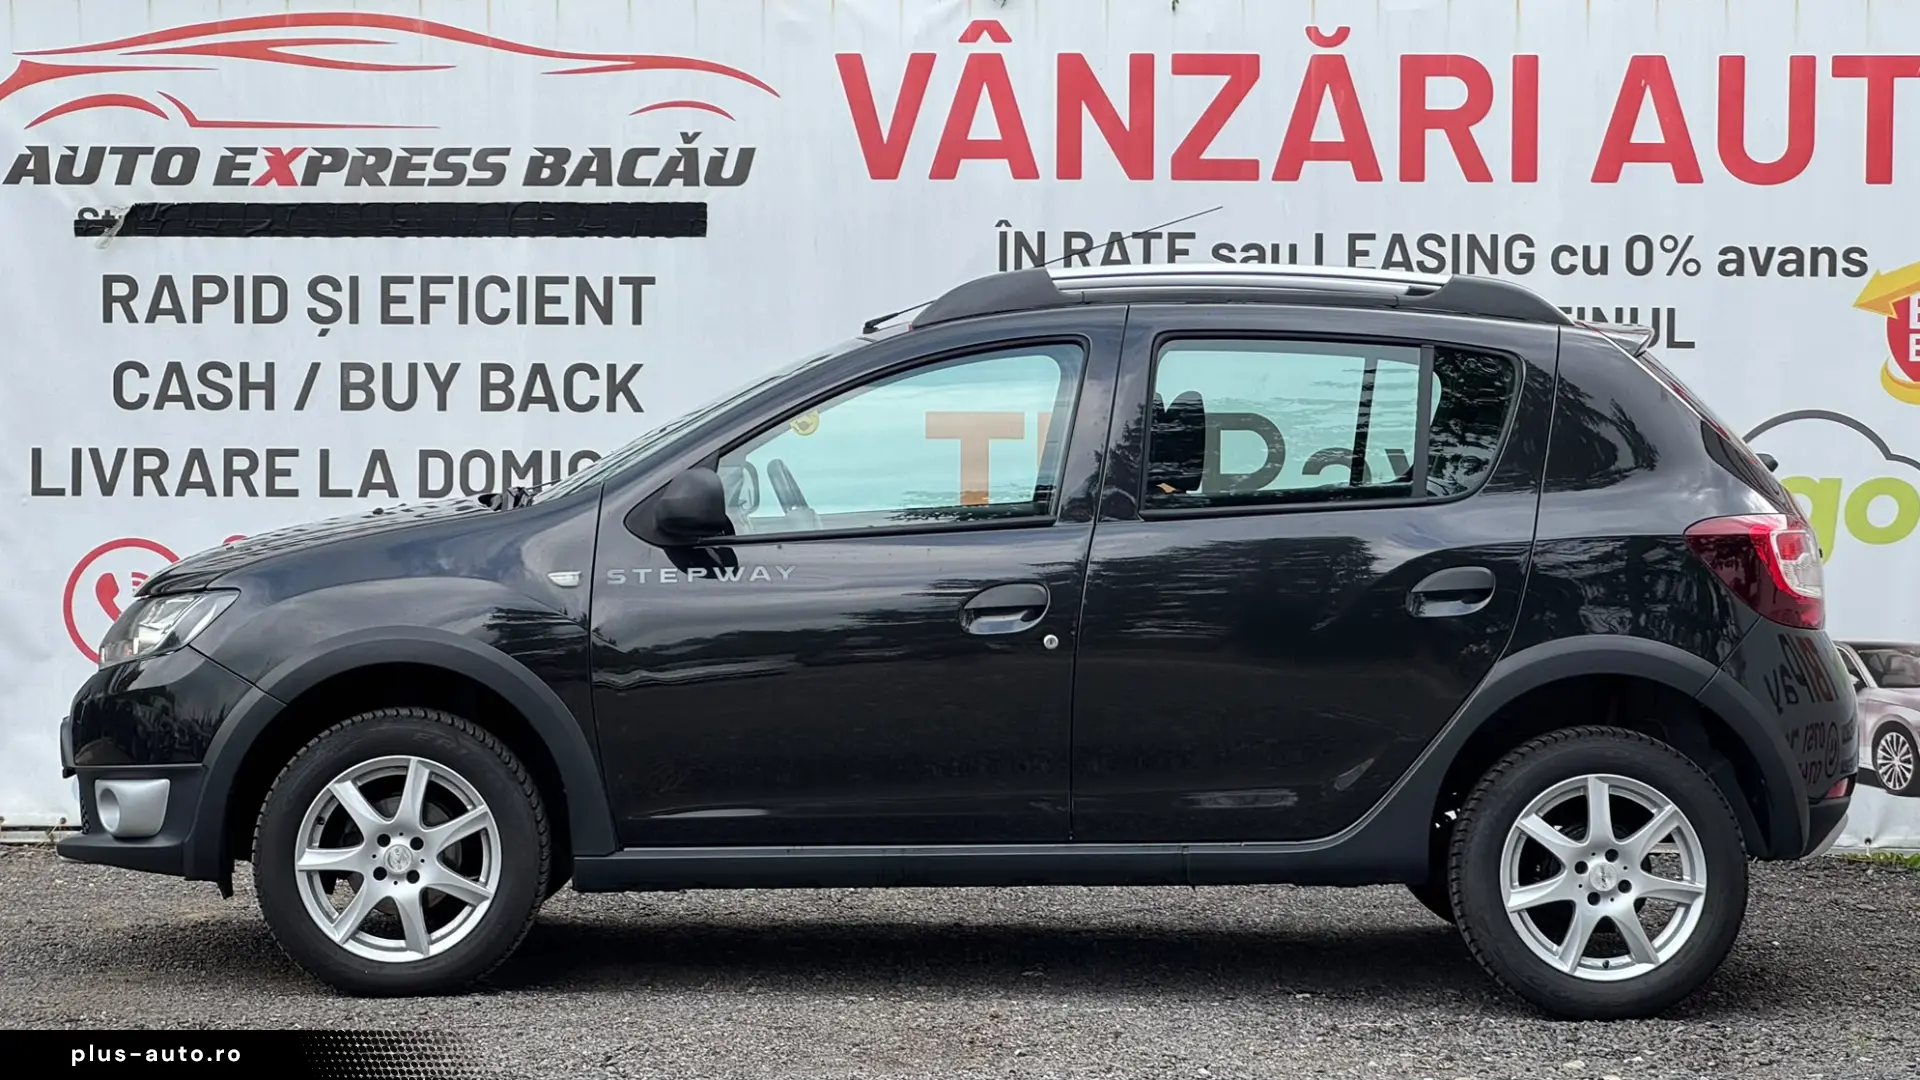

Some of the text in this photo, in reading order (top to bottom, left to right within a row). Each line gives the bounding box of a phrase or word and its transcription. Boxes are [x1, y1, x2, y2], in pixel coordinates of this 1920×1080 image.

[835, 20, 1920, 186] VÂNZĂRI AUT
[3, 131, 756, 187] AUTO EXPRESS BACĂU
[995, 219, 1046, 272] ÎN
[1551, 245, 1609, 276] cu
[1625, 234, 1702, 277] 0%
[1717, 245, 1869, 278] avans
[102, 274, 656, 337] RAPID ȘI EFICIENT
[113, 360, 644, 413] CASH / BUY BACK
[31, 447, 300, 498] LIVRARE
[319, 448, 400, 499] LA
[606, 565, 797, 585] STEPWAY
